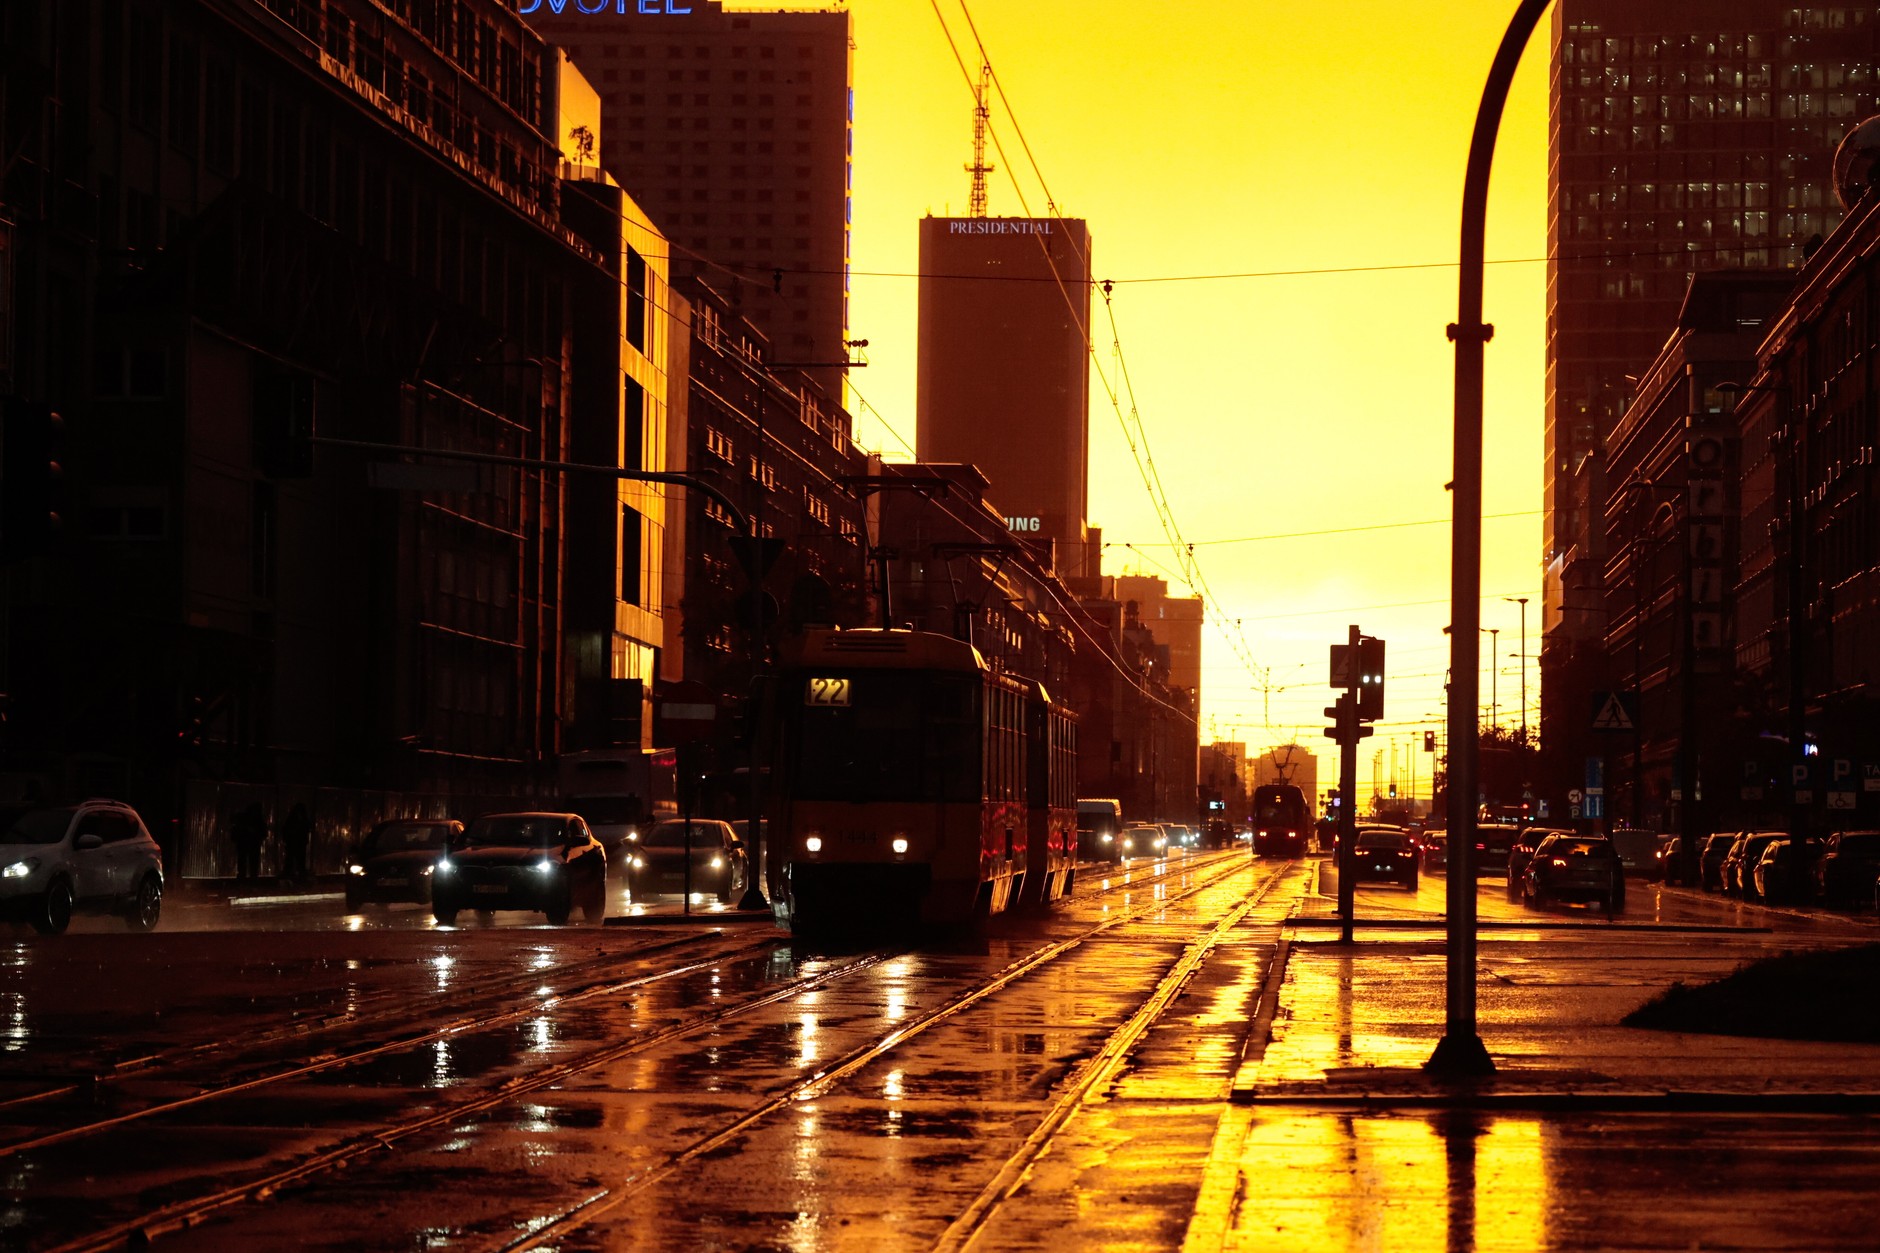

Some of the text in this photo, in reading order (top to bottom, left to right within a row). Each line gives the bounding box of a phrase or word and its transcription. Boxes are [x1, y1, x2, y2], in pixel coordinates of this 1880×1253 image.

[950, 222, 1053, 234] PRESIDENTIAL
[815, 679, 845, 704] 22
[1792, 765, 1808, 786] P
[1834, 760, 1851, 781] P
